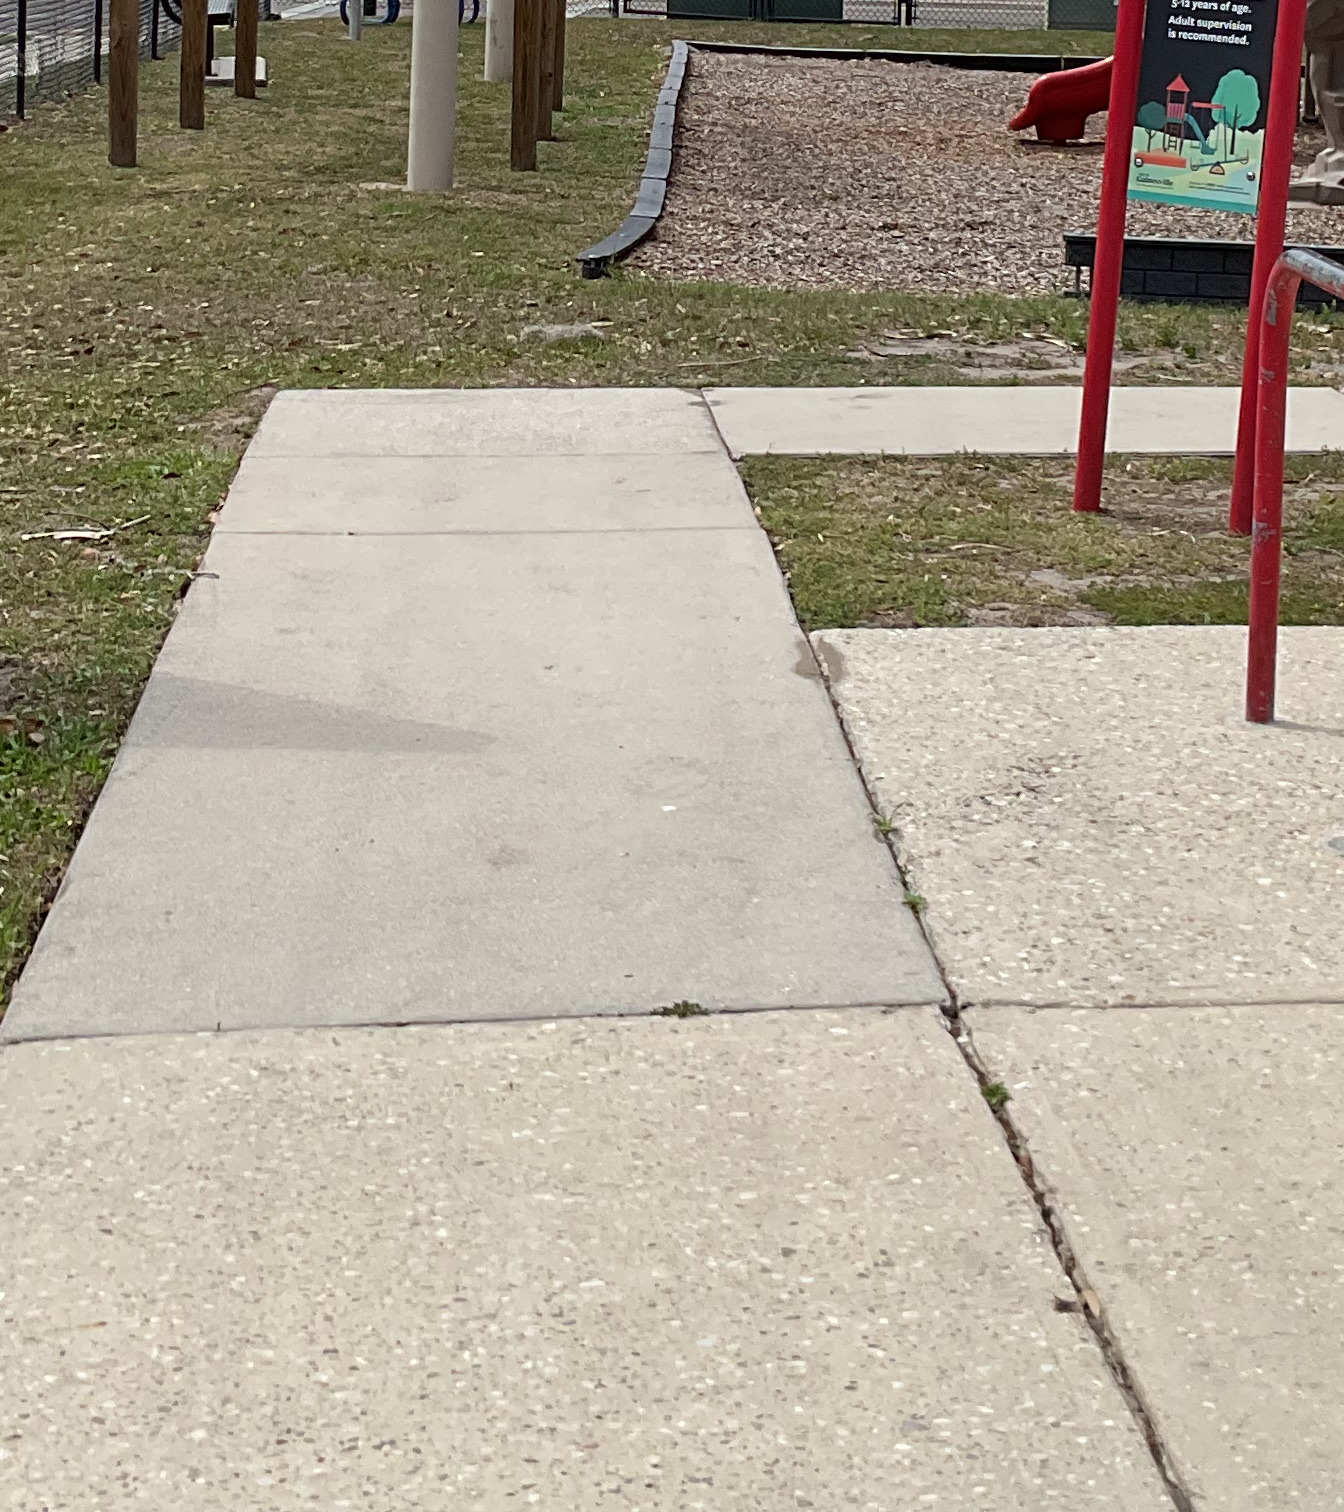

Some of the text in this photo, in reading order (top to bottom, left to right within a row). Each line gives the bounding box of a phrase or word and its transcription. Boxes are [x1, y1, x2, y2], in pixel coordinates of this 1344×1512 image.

[1191, 0, 1218, 11] years
[1219, 1, 1231, 12] of
[1231, 5, 1253, 15] age.
[1168, 15, 1252, 32] Adult supervision
[1167, 27, 1250, 46] is recommended.
